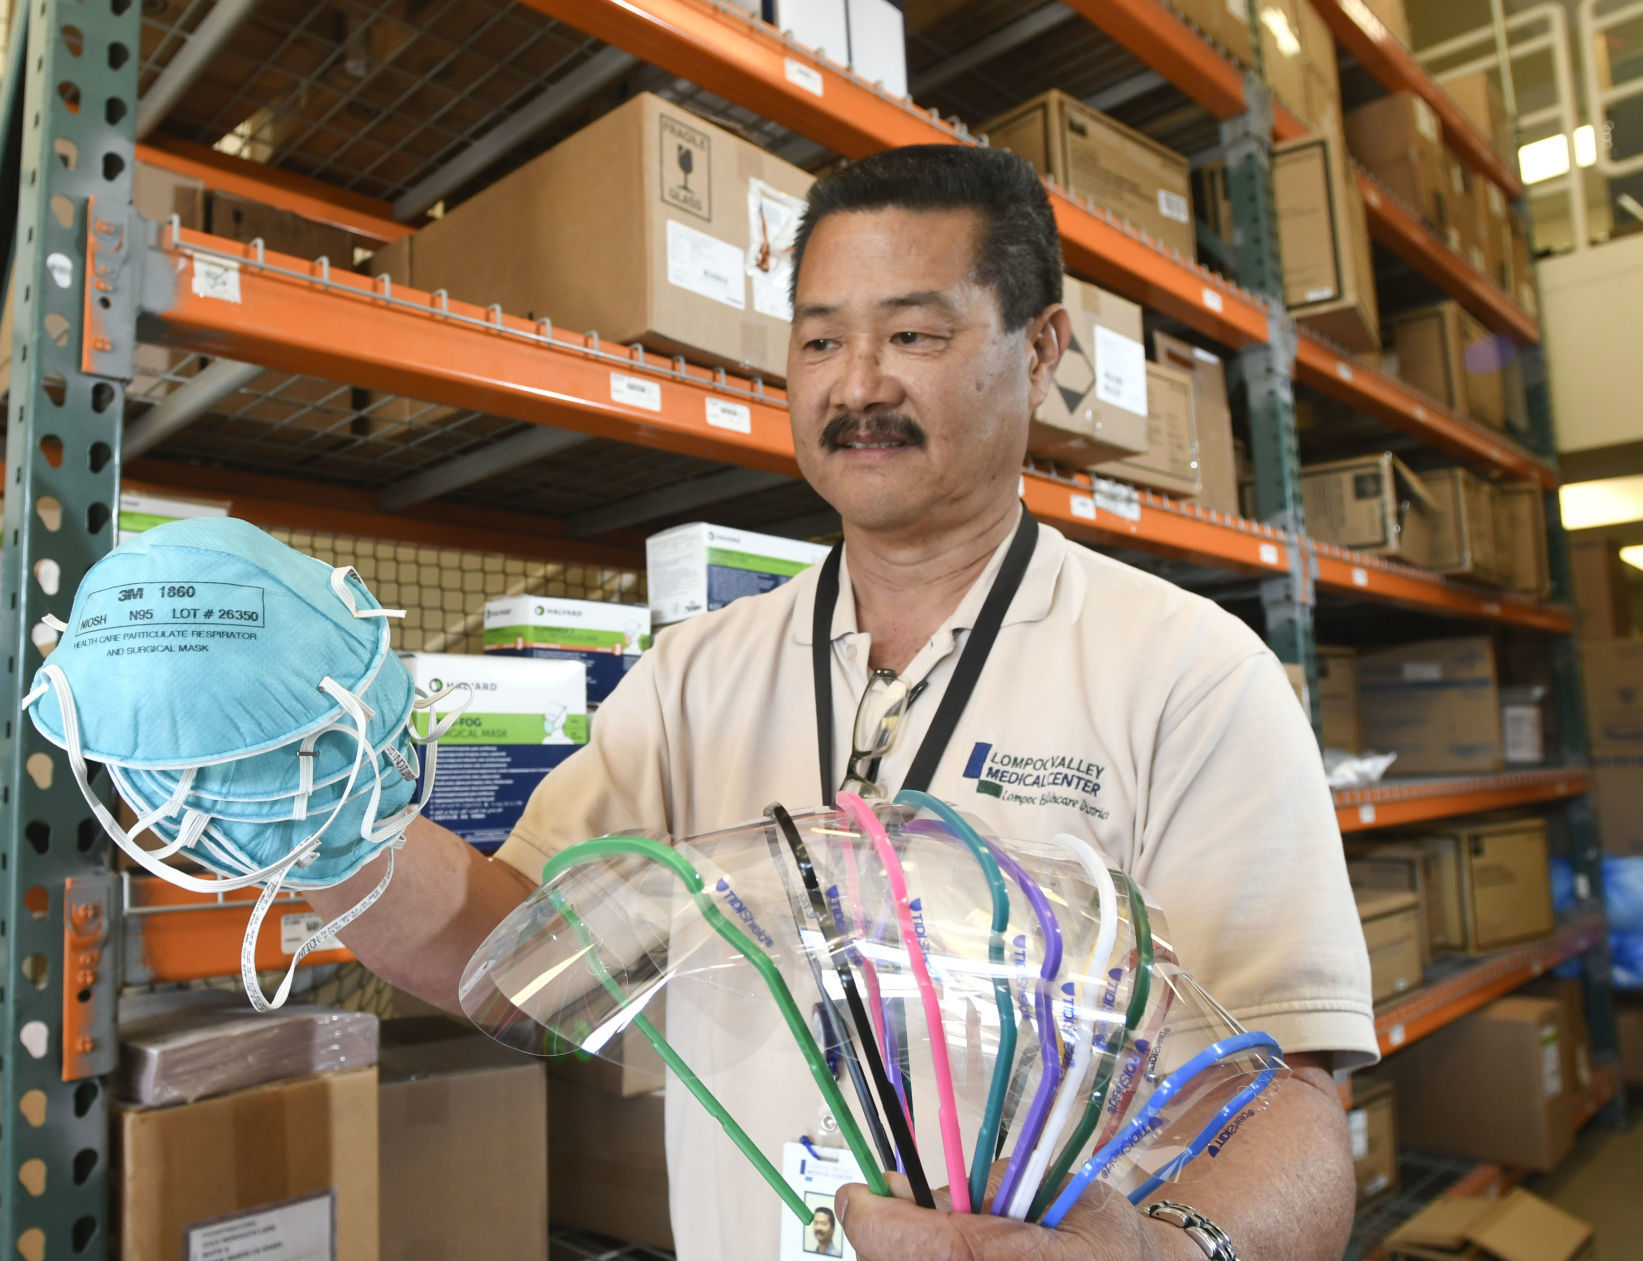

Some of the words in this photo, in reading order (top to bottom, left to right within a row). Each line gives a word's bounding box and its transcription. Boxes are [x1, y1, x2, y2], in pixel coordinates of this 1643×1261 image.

[663, 121, 705, 150] FRAGILE
[668, 188, 703, 211] GLASS
[117, 587, 144, 602] 3M
[159, 586, 196, 598] 1860
[80, 614, 107, 630] NIOSH
[129, 609, 154, 621] N95
[172, 608, 199, 619] LOT
[203, 609, 214, 619] #
[218, 609, 259, 622] 26350
[73, 637, 98, 649] HEALTH
[99, 633, 121, 644] CARE
[123, 630, 187, 641] PARTICULATE
[191, 630, 257, 640] RESPIRATOR
[106, 646, 124, 657] AND
[126, 644, 174, 655] SURGICAL
[178, 643, 209, 652] MASK
[482, 729, 508, 738] MASK
[990, 752, 1050, 771] LOMPOC
[1051, 756, 1105, 780] VALLEY
[986, 767, 1046, 787] MEDICAL
[1047, 772, 1101, 797] CENTER
[1002, 790, 1037, 806] Lompoc
